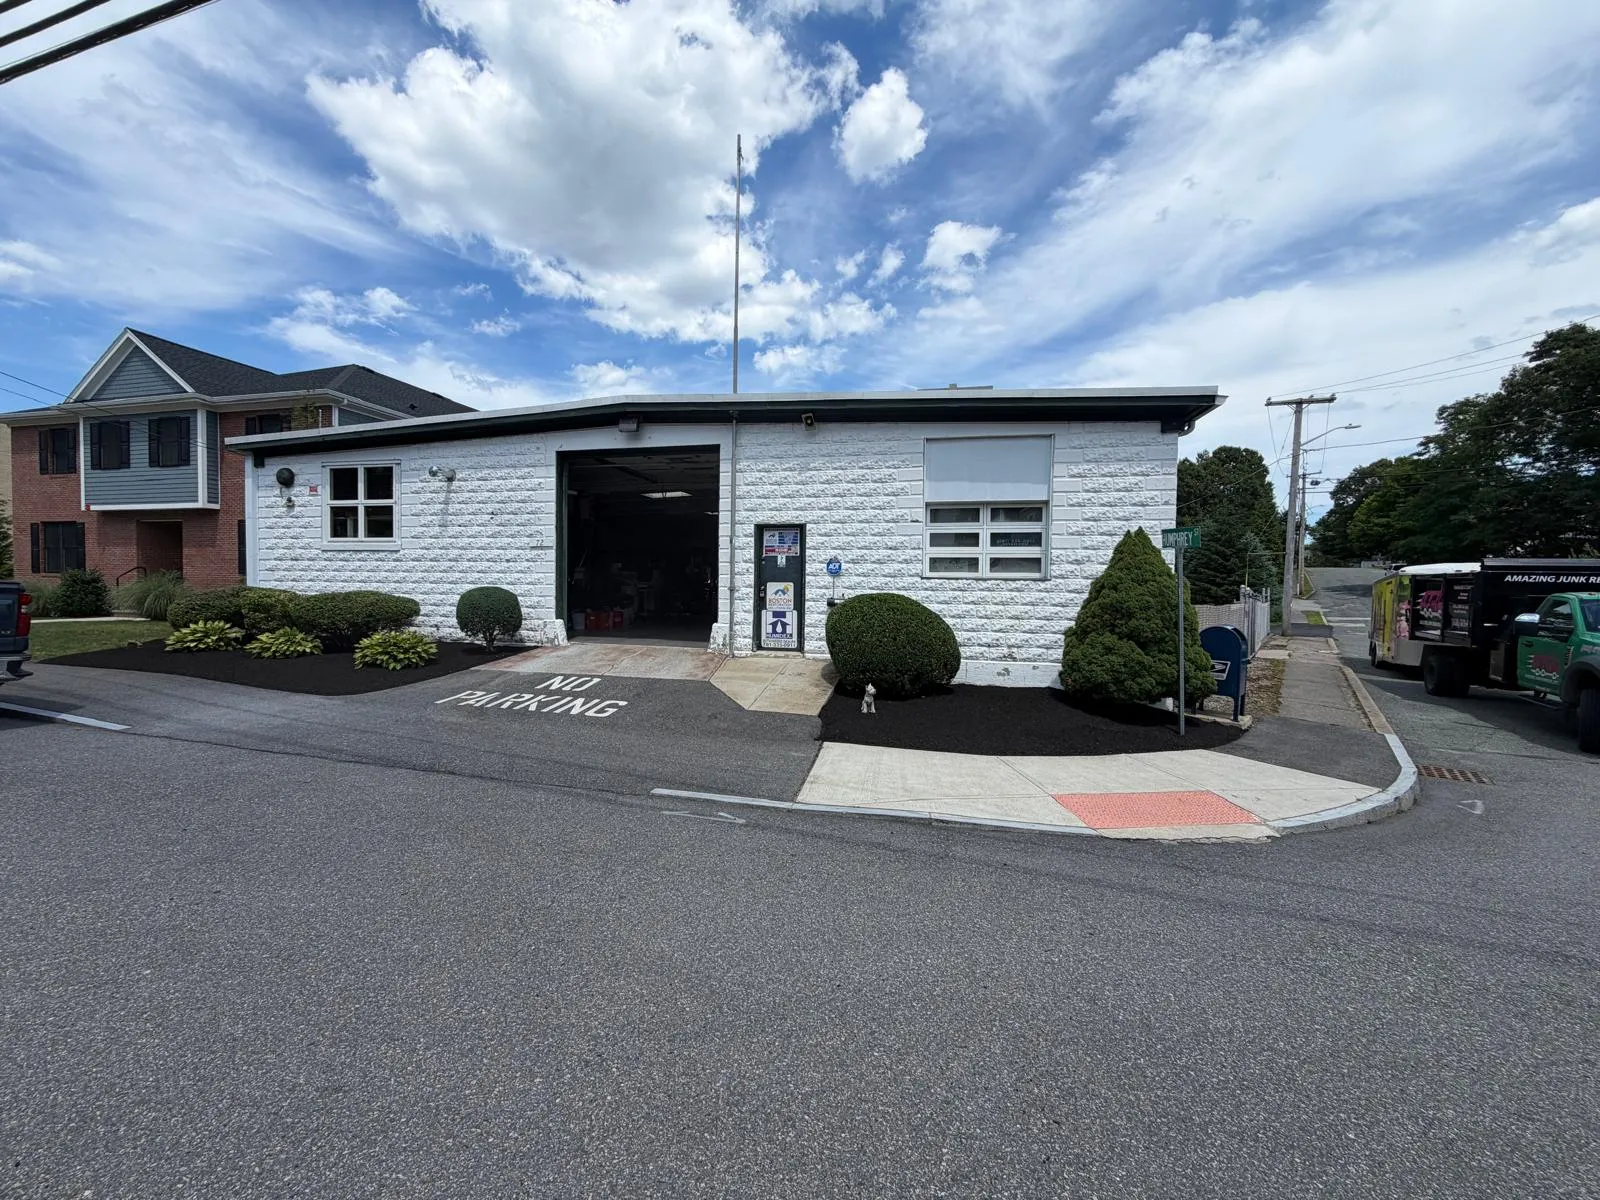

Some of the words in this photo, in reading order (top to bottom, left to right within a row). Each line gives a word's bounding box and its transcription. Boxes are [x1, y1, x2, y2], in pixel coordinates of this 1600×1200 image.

[1163, 531, 1193, 547] HUMPHREY
[828, 562, 840, 570] ADT
[1504, 575, 1556, 583] AMAZING
[535, 675, 601, 692] NO
[434, 690, 629, 718] PARKING
